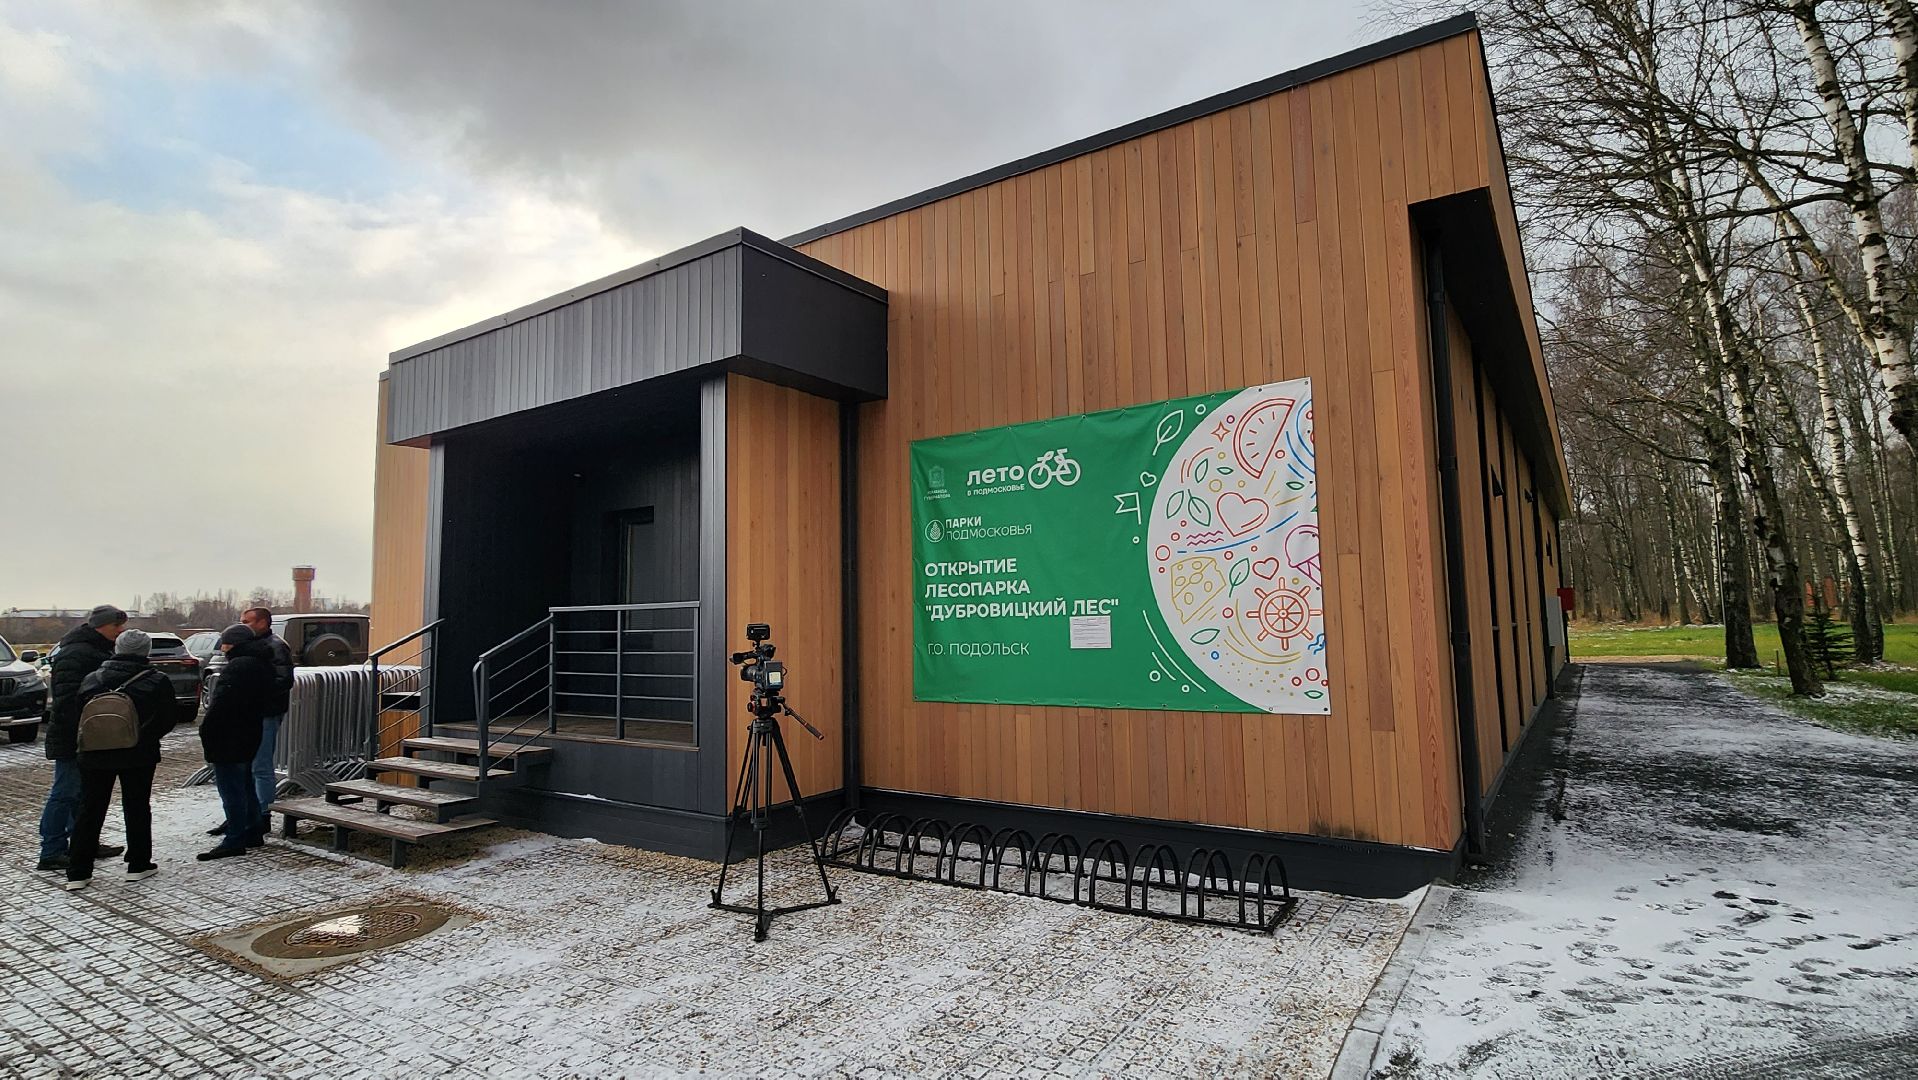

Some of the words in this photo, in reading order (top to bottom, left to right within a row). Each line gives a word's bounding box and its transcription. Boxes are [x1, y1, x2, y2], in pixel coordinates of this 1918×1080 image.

[966, 465, 1025, 486] лето
[973, 484, 1025, 495] ПОДМОСКОВЬЕ
[945, 516, 982, 528] ПАРКИ
[946, 524, 1032, 541] ПОДМОСКОВЬЯ
[924, 558, 1018, 577] ОТКРЫТИЕ
[924, 579, 1031, 599] ЛЕСОПАРКА
[925, 597, 1067, 622] "ДУБРОВИЦКИЙ
[1071, 598, 1120, 616] ЛЕС"
[927, 643, 946, 656] Г.О.
[949, 642, 1030, 658] ПОДОЛЬСК
